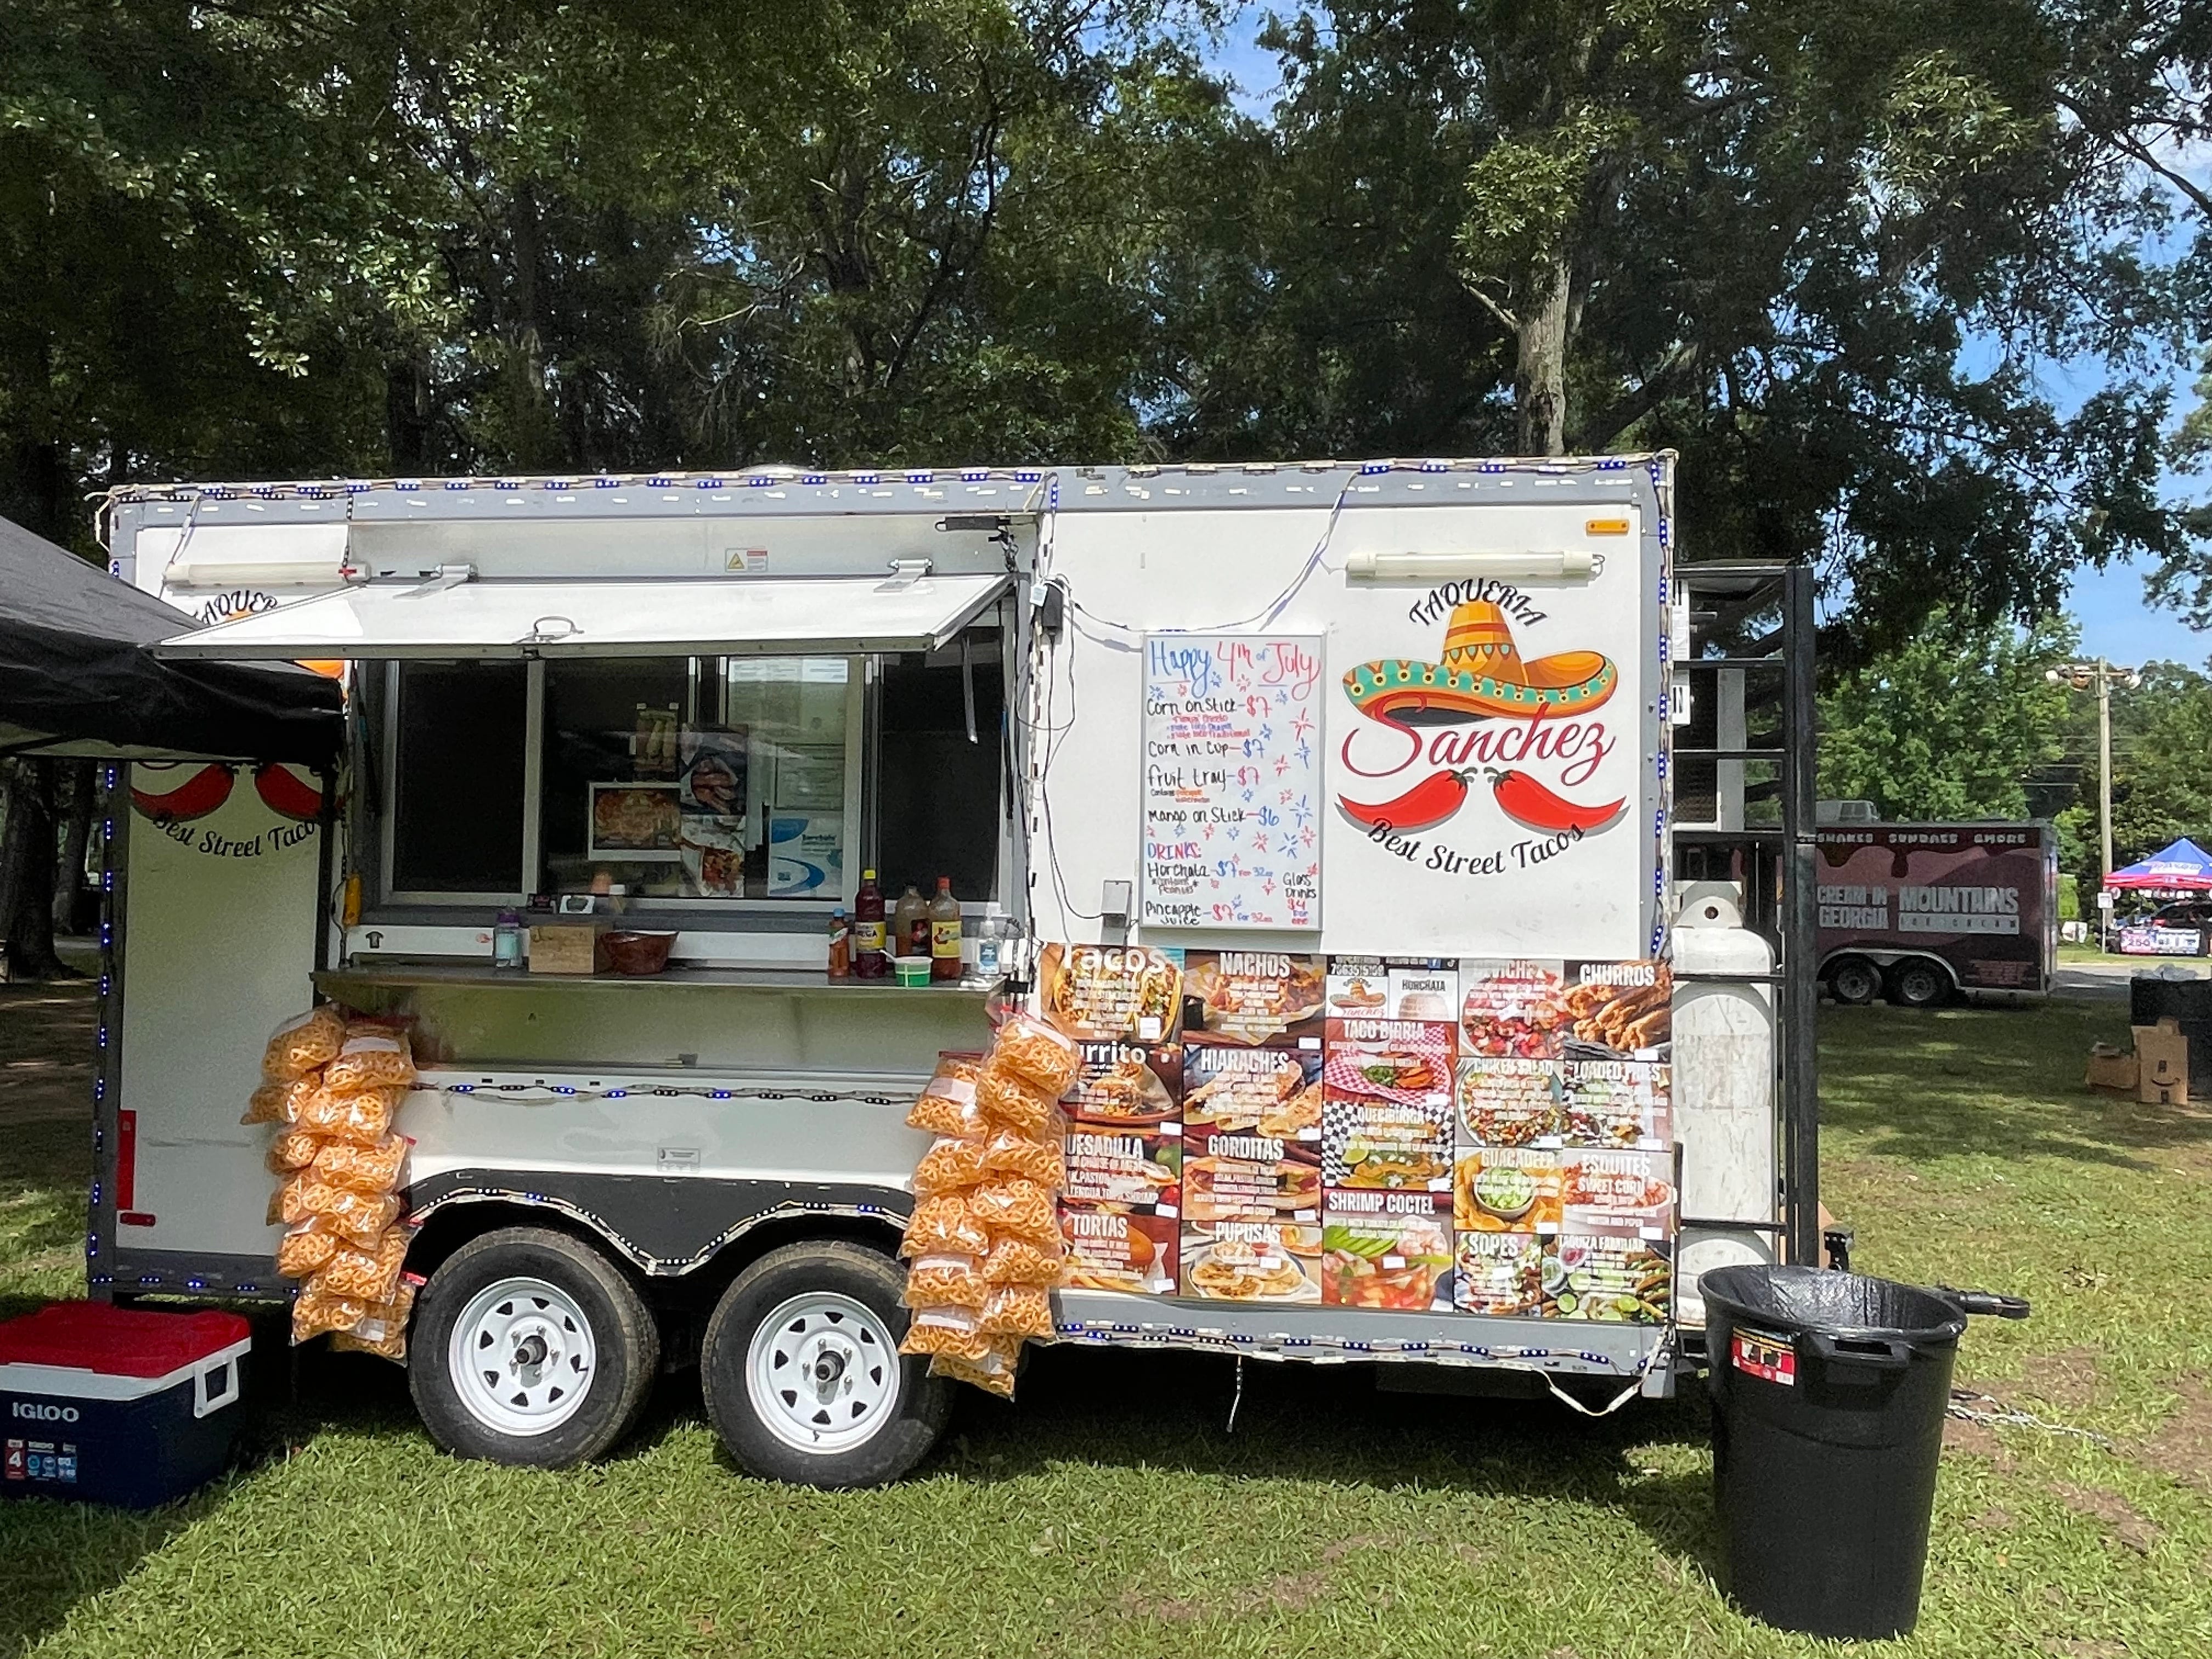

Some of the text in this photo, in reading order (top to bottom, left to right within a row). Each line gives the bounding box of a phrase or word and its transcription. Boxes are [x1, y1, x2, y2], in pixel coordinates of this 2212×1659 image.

[1409, 577, 1548, 627] TAQUERIA
[1149, 641, 1212, 699] Happy
[1263, 642, 1321, 701] July
[1147, 698, 1180, 716] Corn
[1185, 701, 1203, 713] on
[1204, 698, 1238, 714] Stick
[1148, 741, 1181, 757] Corn
[1186, 742, 1202, 756] in
[1206, 741, 1229, 758] Cup
[1341, 690, 1617, 787] Sanchez
[1147, 764, 1186, 789] fruit
[1192, 768, 1227, 792] tray
[1193, 810, 1208, 823] on
[1211, 806, 1246, 823] Stick
[199, 830, 262, 857] Street
[268, 821, 318, 851] Taco
[1367, 817, 1587, 874] Best Street Tacos
[1888, 833, 1959, 844] SUNDAES
[1147, 862, 1210, 878] Horchata
[1146, 901, 1202, 917] Pineapple
[1898, 886, 2019, 914] MOUNTAINS
[1819, 905, 1889, 929] GEORGIA
[1220, 952, 1291, 978] NACHOS
[1579, 963, 1655, 987] CHURROS
[1344, 1020, 1381, 1039] TACO
[1079, 1040, 1146, 1064] rrito
[1067, 1133, 1144, 1160] UESADILLA
[1208, 1135, 1285, 1161] GORDITAS
[1581, 1154, 1651, 1176] ESQUITES
[1328, 1192, 1436, 1215] SHRIMP COCTEL
[1072, 1214, 1128, 1239] TORTAS
[1215, 1222, 1282, 1243] PUPUSAS
[1469, 1234, 1519, 1257] SOPES
[12, 1402, 80, 1422] IGLOO
